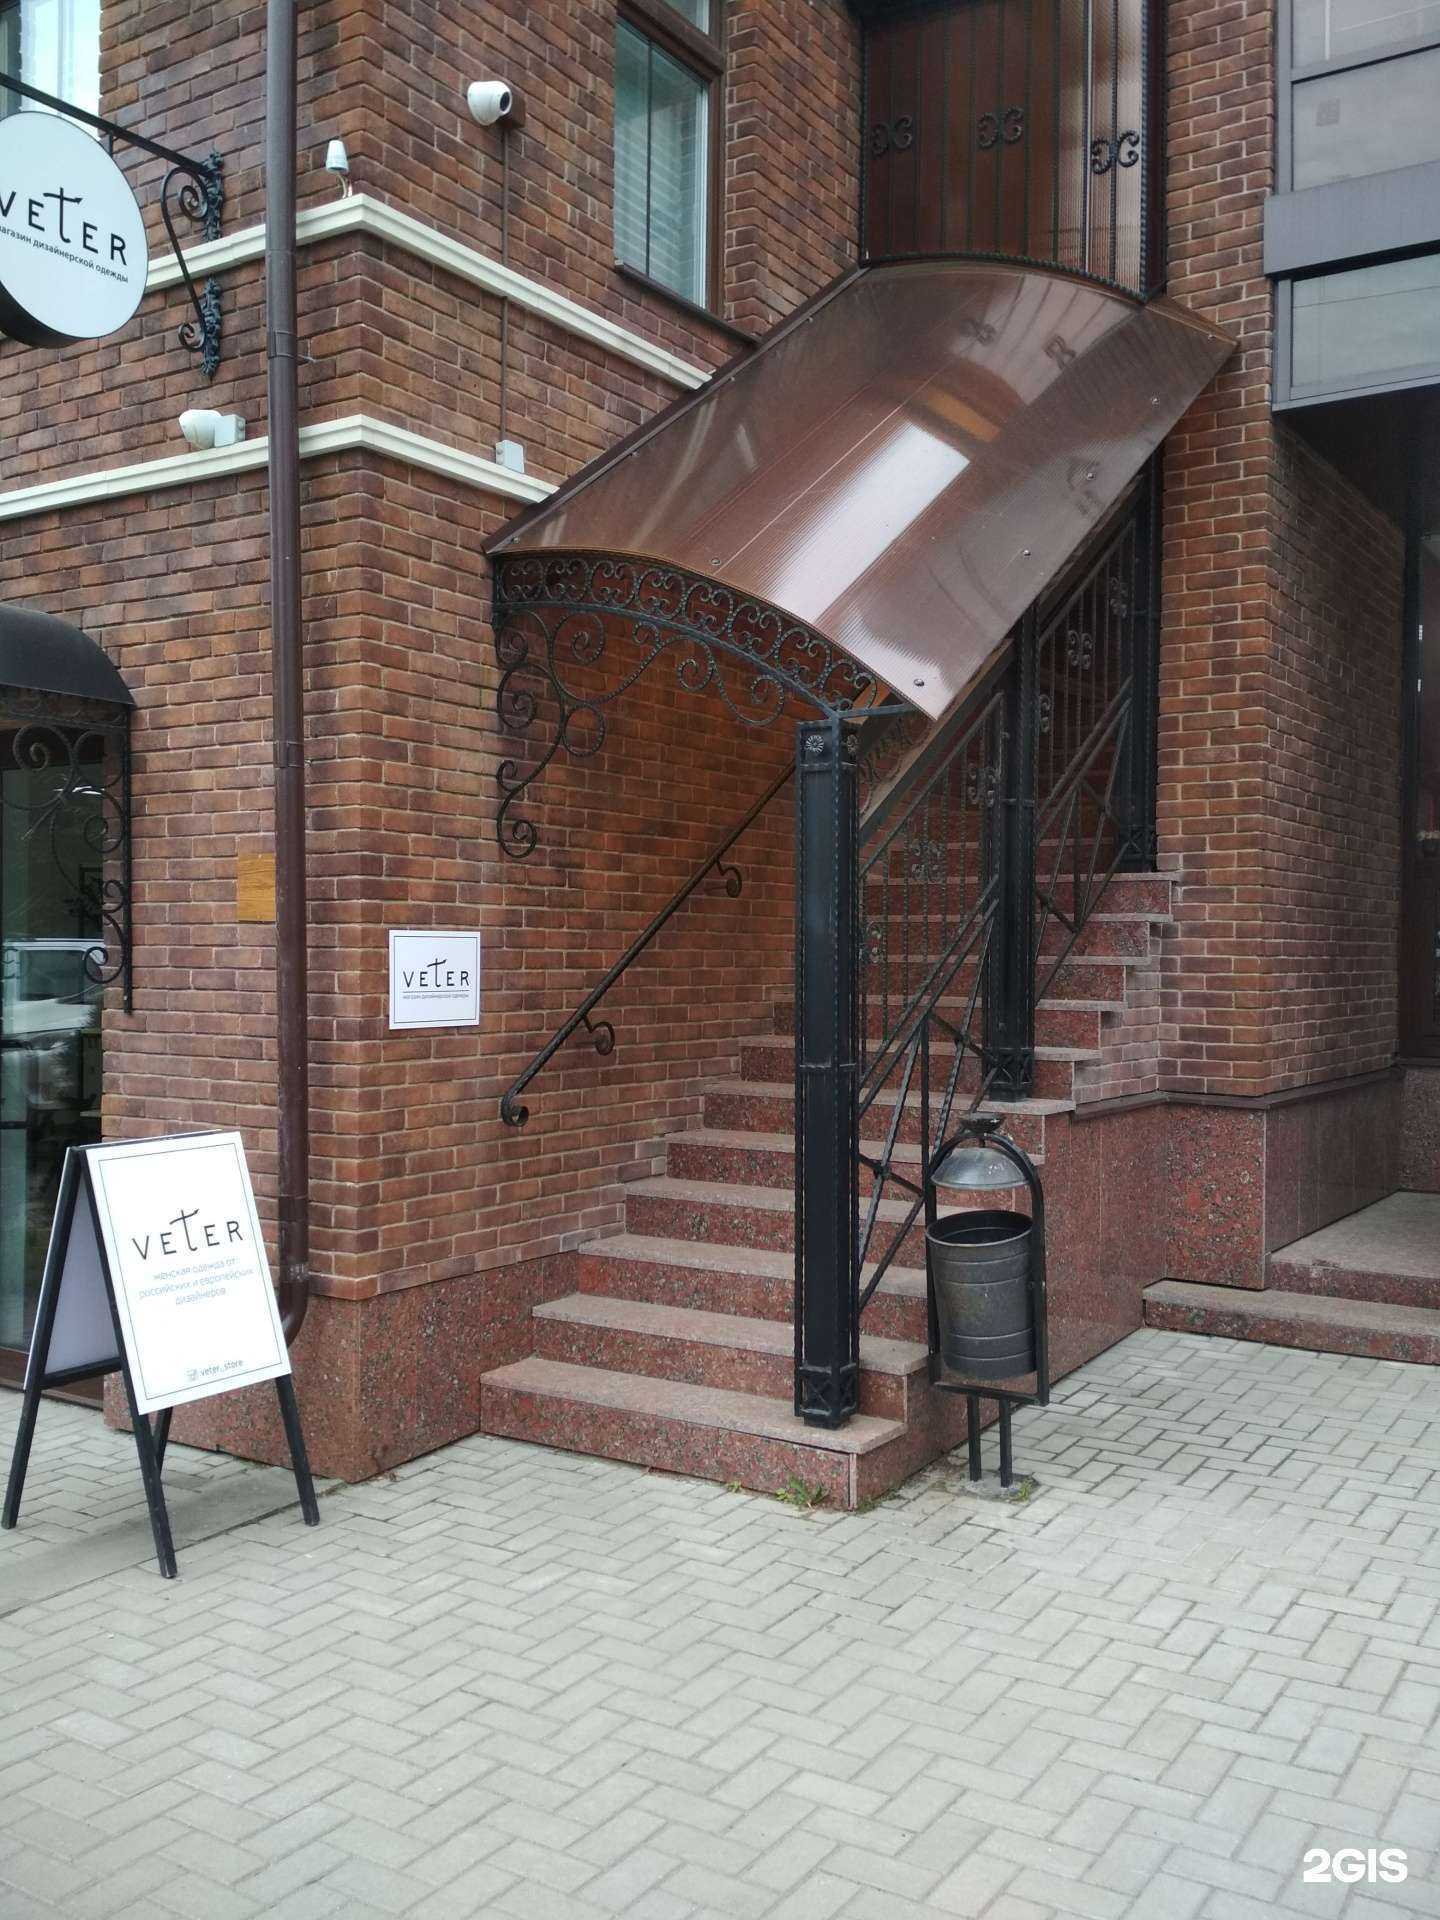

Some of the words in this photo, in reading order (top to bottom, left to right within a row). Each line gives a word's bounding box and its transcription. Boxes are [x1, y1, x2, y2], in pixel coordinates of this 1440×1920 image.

[0, 225, 32, 244] агазин
[33, 239, 95, 270] дизайнерской
[95, 264, 129, 283] одежды
